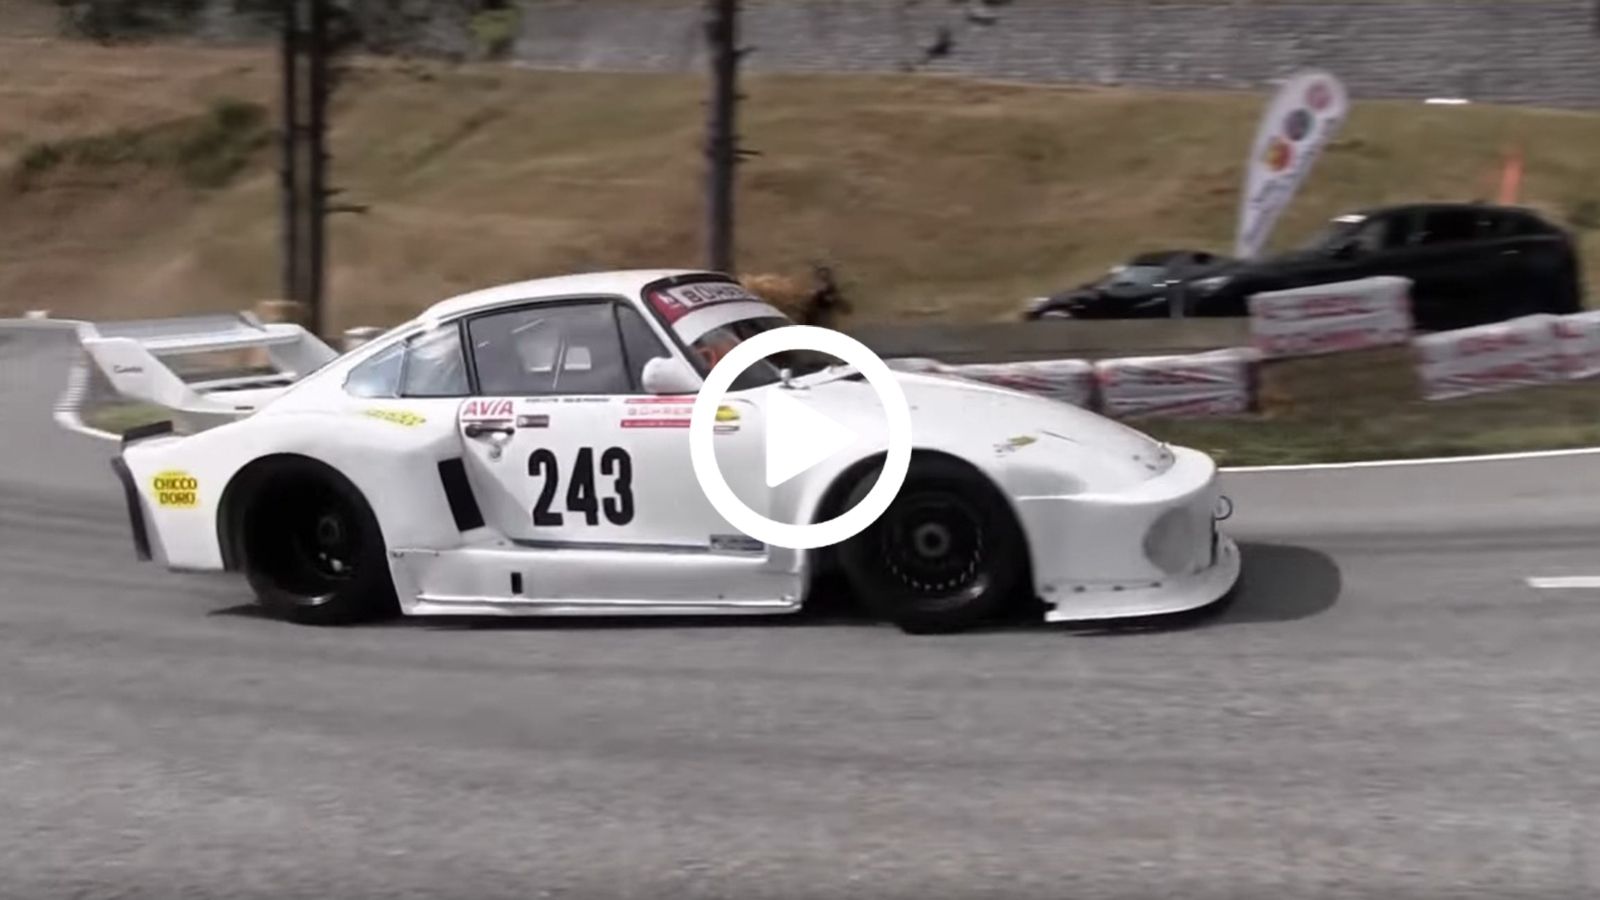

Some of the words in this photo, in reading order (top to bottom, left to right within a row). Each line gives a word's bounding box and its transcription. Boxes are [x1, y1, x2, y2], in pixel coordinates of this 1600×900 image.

[463, 401, 514, 416] AVIA
[153, 477, 198, 490] CHICCO
[528, 446, 634, 526] 243
